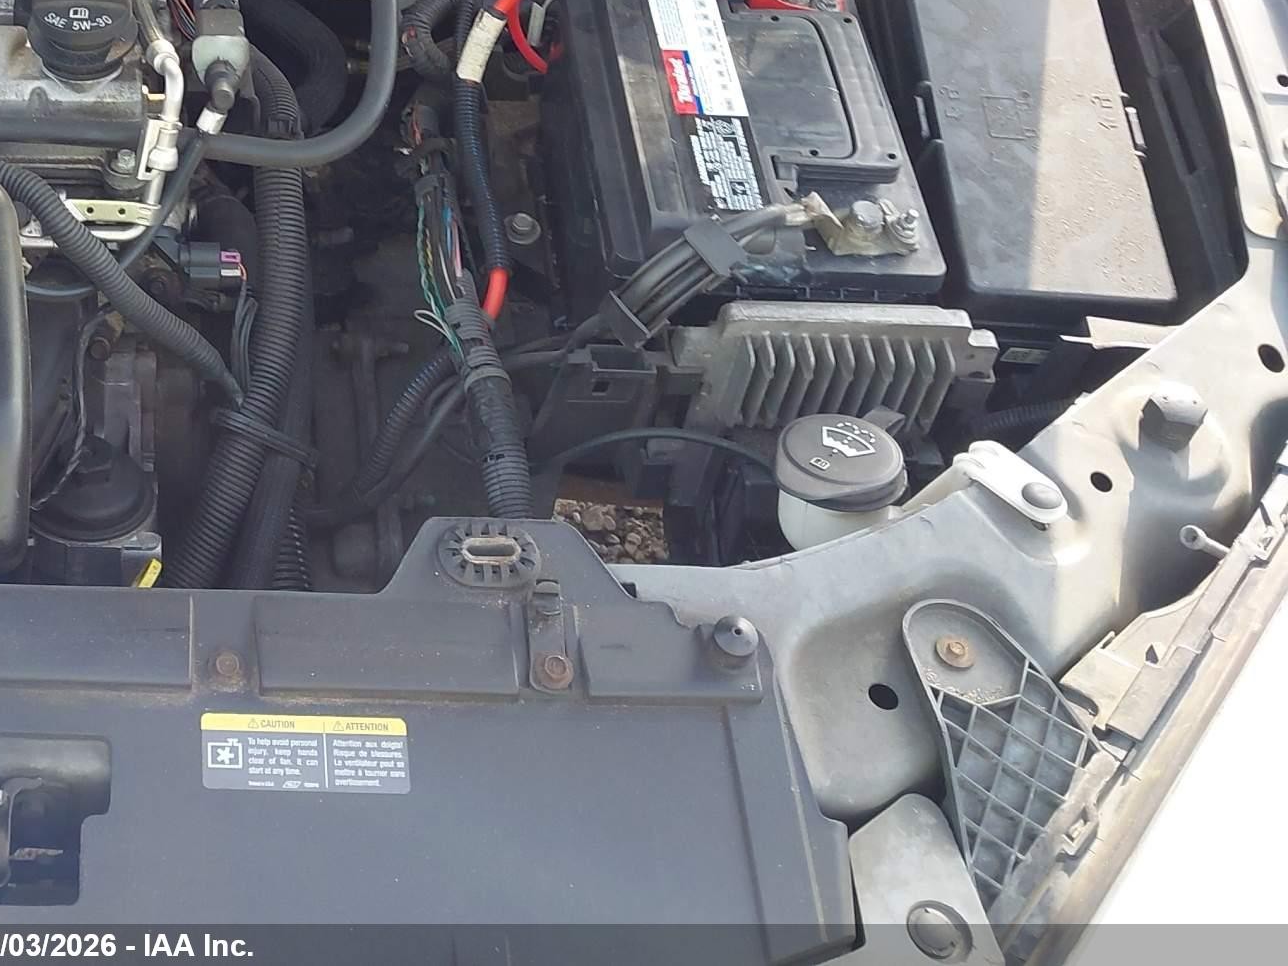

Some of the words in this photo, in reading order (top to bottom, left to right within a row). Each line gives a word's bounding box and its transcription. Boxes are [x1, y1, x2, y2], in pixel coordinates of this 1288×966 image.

[44, 12, 67, 28] SAE
[72, 15, 112, 30] 5W-30
[261, 720, 295, 728] CAUTION
[346, 722, 388, 730] ATTENTION
[257, 738, 271, 746] help
[290, 739, 317, 748] personal
